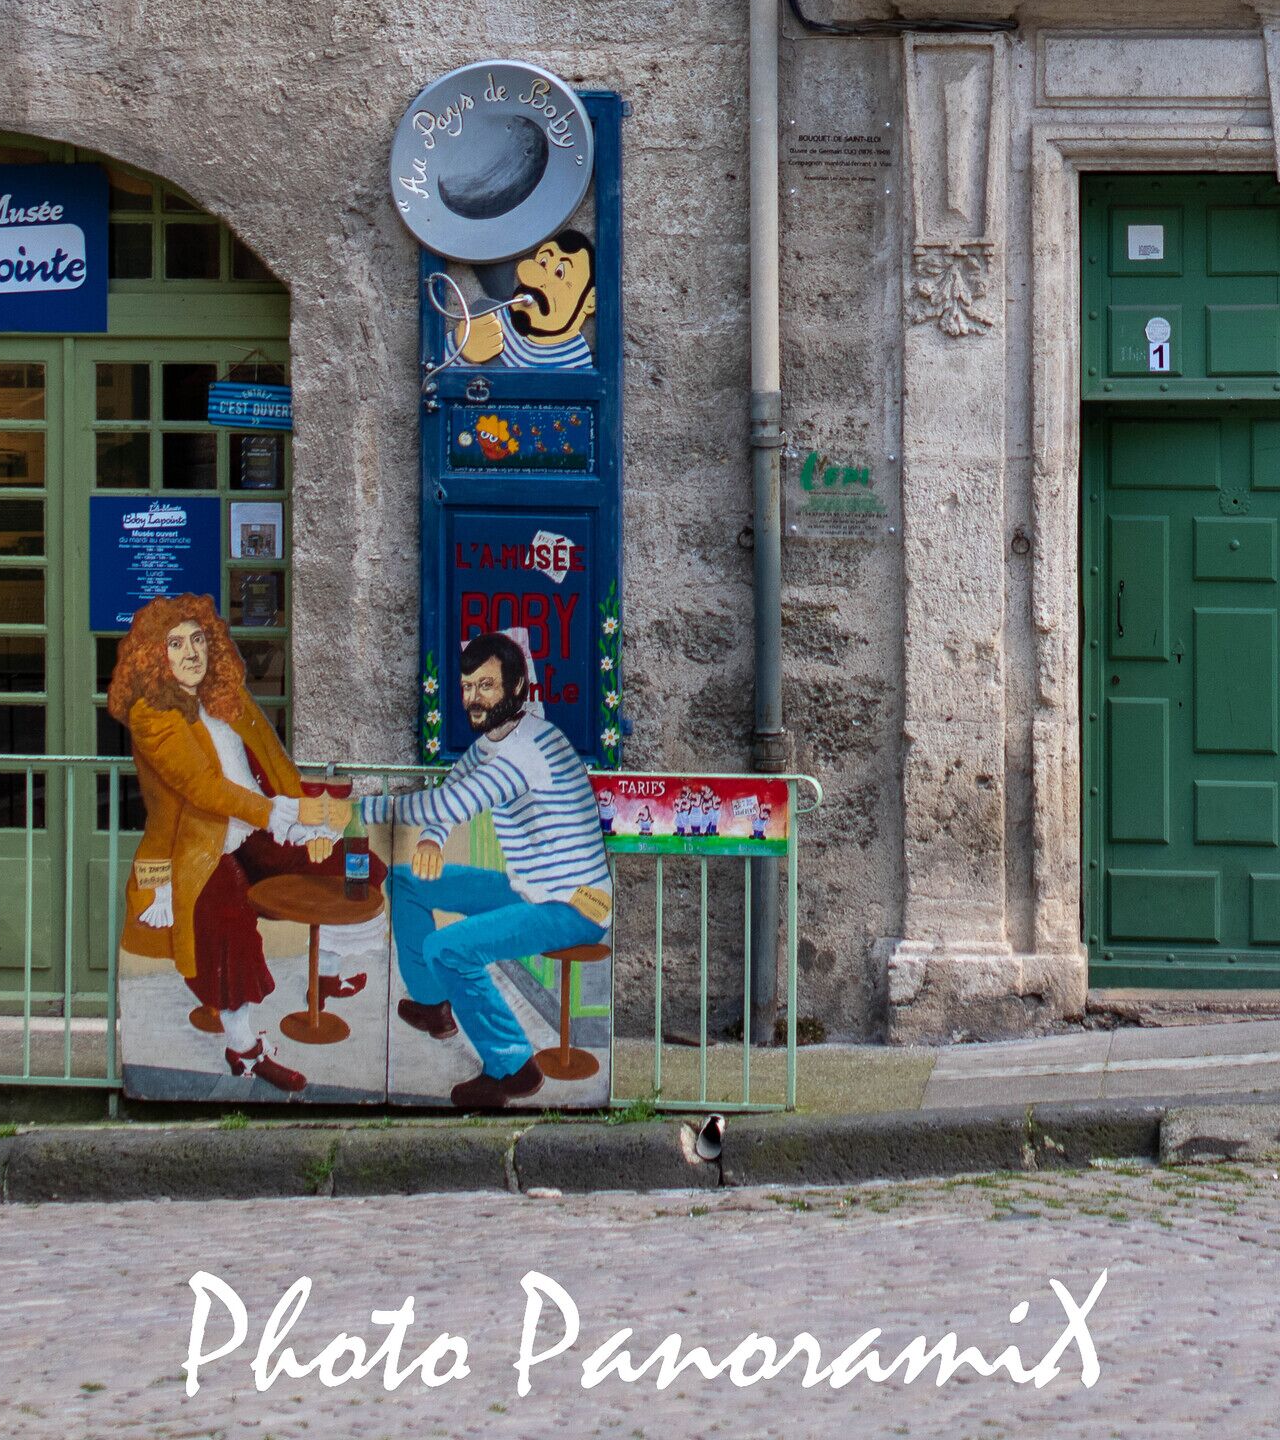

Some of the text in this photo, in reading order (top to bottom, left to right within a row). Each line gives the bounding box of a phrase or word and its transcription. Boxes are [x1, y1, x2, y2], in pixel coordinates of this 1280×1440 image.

[412, 93, 475, 150] Pays
[484, 73, 510, 102] de
[799, 135, 829, 143] BOUQUET
[1153, 344, 1164, 369] 1
[219, 400, 248, 415] C'EST
[147, 513, 186, 527] Lapointe
[455, 537, 586, 572] L'A-MUSÉE
[461, 591, 580, 659] BOBY
[618, 780, 666, 797] TARIFS
